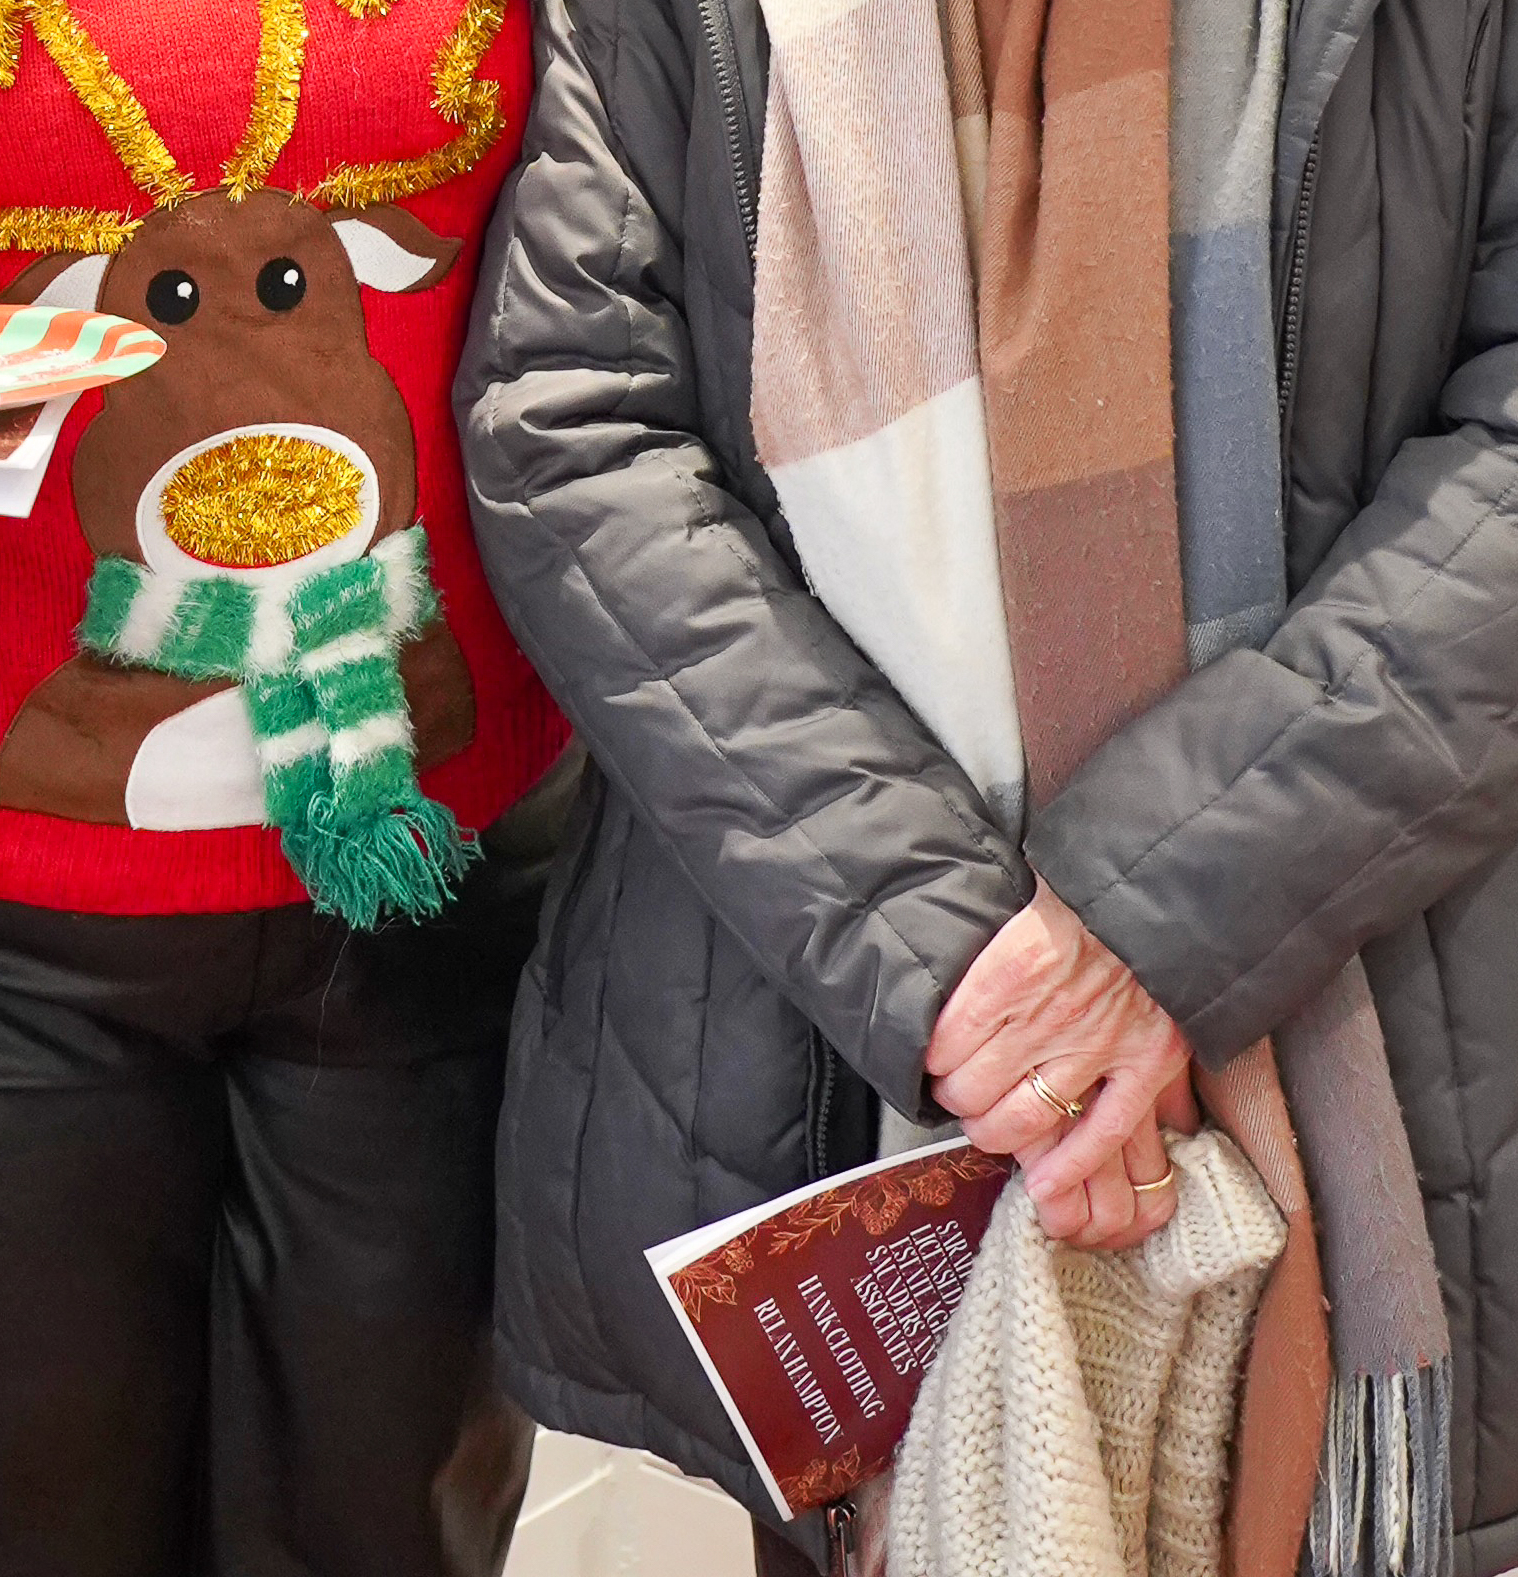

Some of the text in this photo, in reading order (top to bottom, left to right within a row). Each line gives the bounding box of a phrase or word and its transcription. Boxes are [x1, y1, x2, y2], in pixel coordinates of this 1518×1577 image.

[865, 1245, 926, 1337] SAUNDERS
[888, 1236, 936, 1309] ESTATE
[910, 1223, 968, 1304] LICENSED
[753, 1297, 844, 1444] RELAX HAMPTON
[797, 1274, 885, 1418] HANK CLOTHING
[850, 1273, 918, 1375] ASSOCIATES
